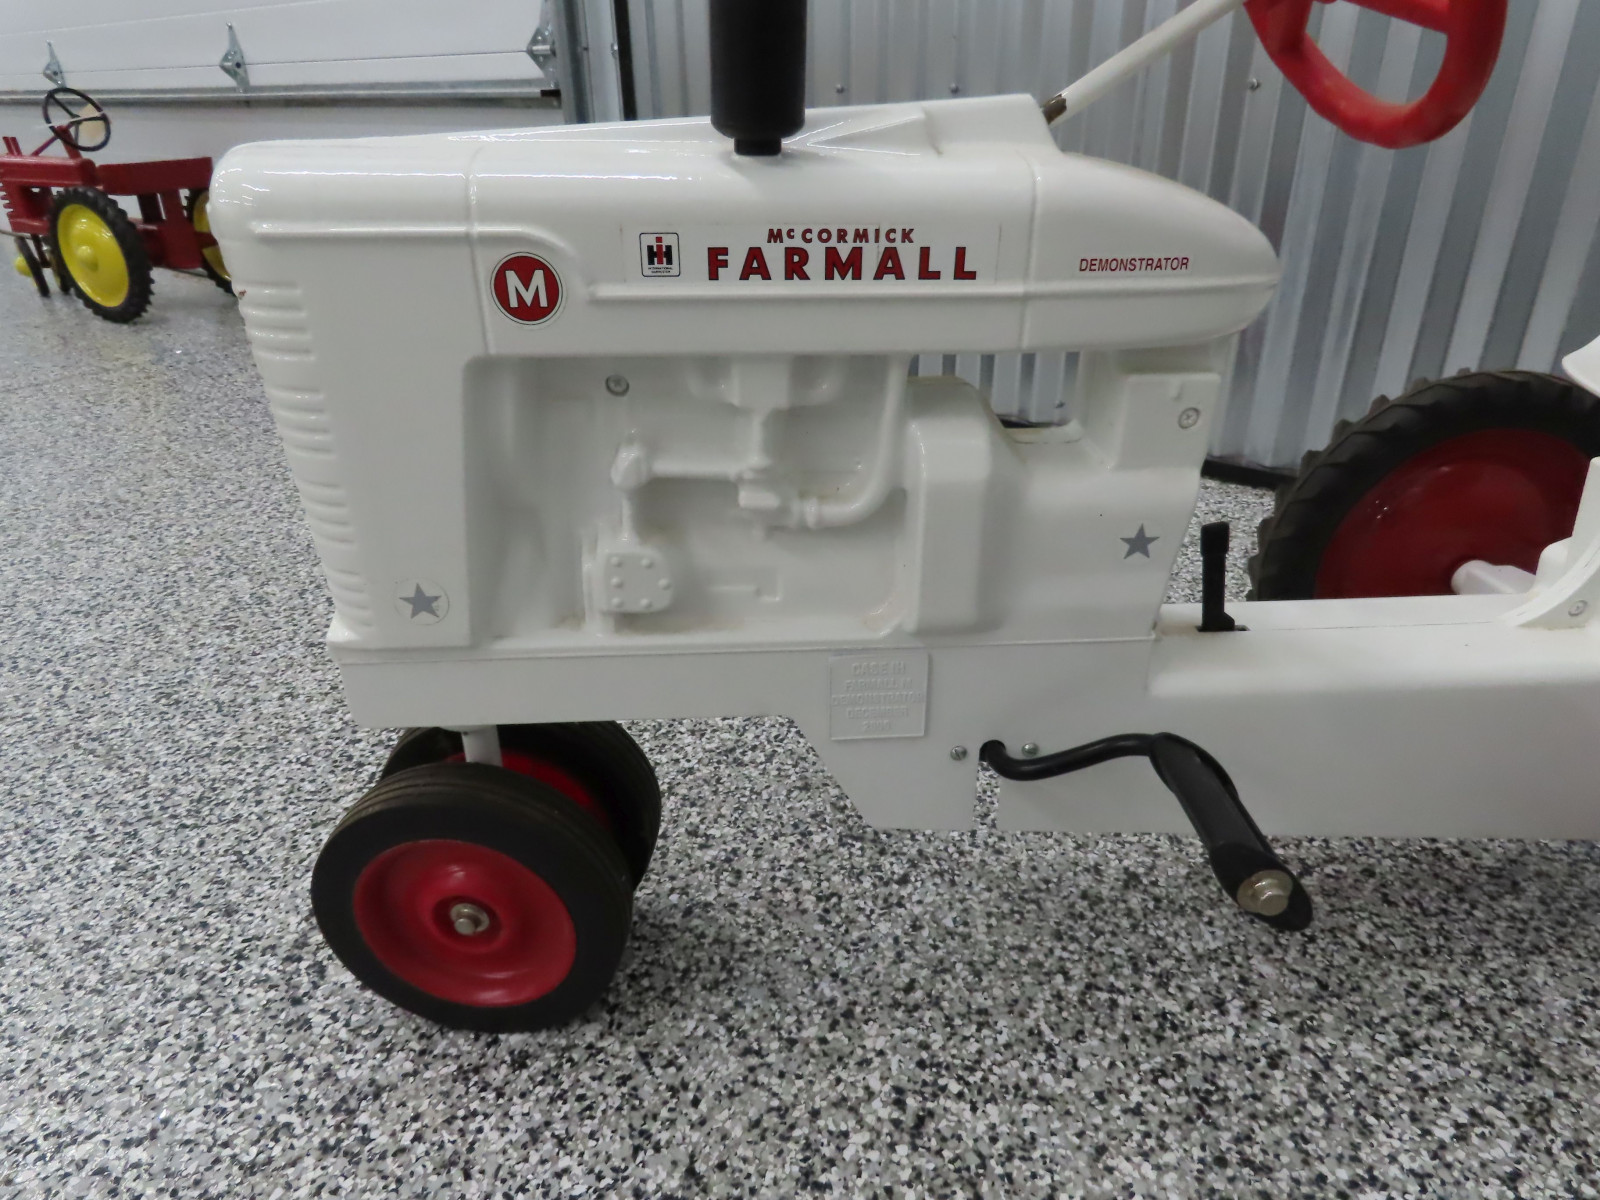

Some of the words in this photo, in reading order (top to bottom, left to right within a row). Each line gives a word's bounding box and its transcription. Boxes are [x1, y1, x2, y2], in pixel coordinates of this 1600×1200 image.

[707, 246, 977, 280] FARMALL
[1079, 257, 1189, 272] DEMONSTRATOR
[505, 269, 548, 308] M
